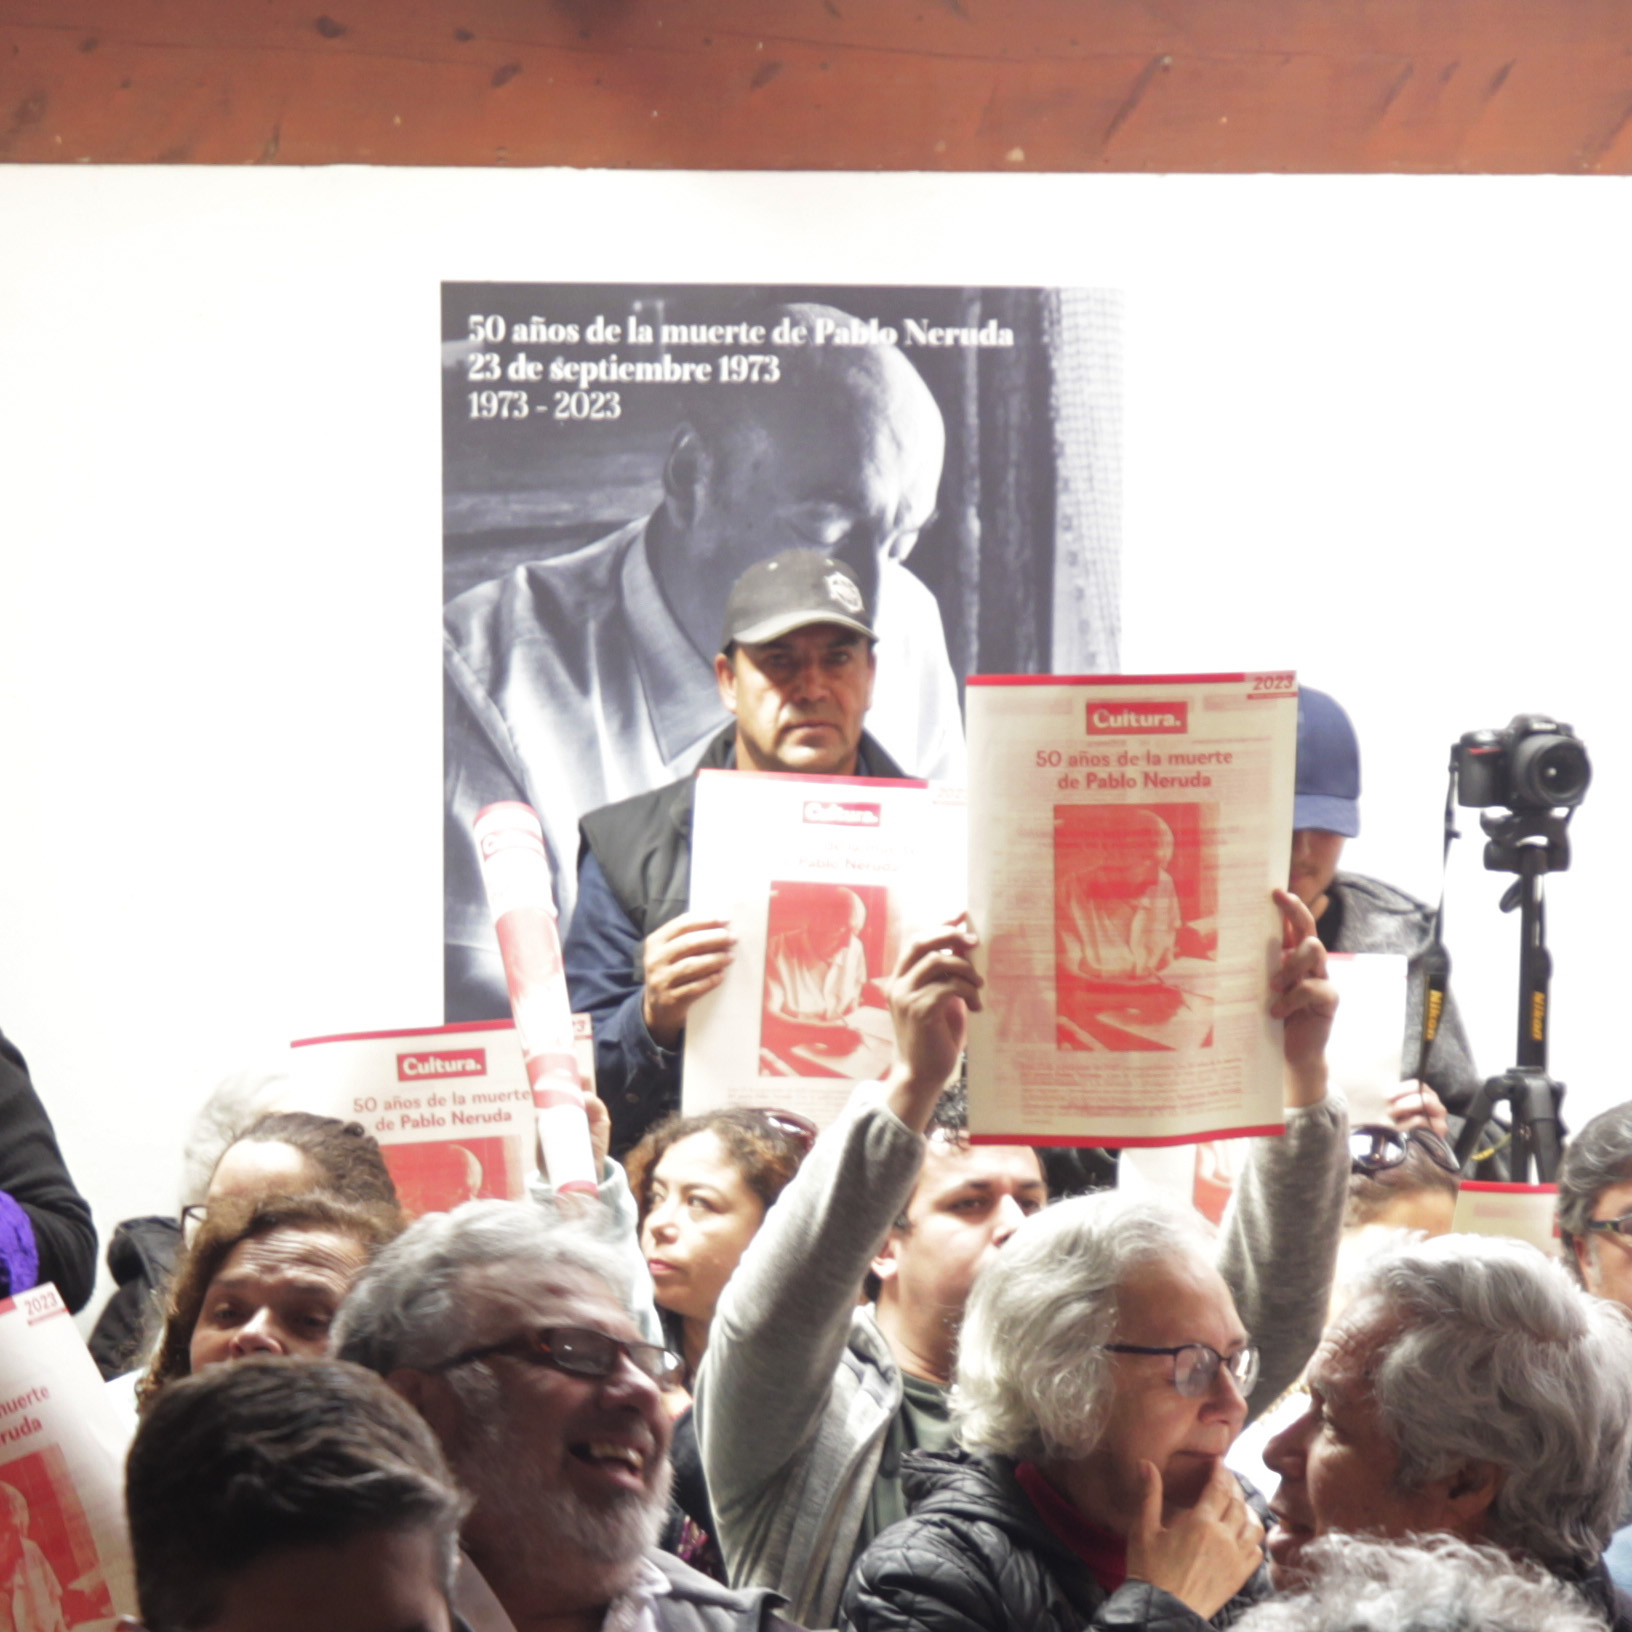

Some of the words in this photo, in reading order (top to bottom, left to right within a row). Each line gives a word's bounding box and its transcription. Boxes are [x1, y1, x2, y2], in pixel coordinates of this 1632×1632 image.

[468, 314, 507, 344] 50
[511, 315, 581, 345] años
[585, 315, 622, 345] de
[626, 315, 654, 345] la
[661, 322, 766, 345] muerte
[771, 316, 808, 346] de
[813, 317, 899, 346] Pablo
[902, 317, 1015, 347] Neruda
[467, 352, 502, 382] 23
[507, 352, 544, 382] de
[549, 353, 713, 389] septiembre
[718, 354, 781, 384] 1973
[467, 390, 529, 419] 1973
[553, 391, 622, 420] 2023
[1252, 676, 1295, 691] 2023
[1093, 709, 1181, 729] Cultura.
[1035, 750, 1062, 768] 50
[1068, 749, 1111, 768] años
[1117, 750, 1140, 767] de
[1146, 749, 1162, 767] la
[1167, 750, 1234, 766] muerte
[1057, 773, 1080, 790] de
[1085, 772, 1137, 790] Pablo
[1143, 771, 1212, 789] Neruda
[402, 1056, 482, 1076] Cultura.
[353, 1096, 378, 1113] 50
[383, 1095, 422, 1111] años
[427, 1092, 447, 1107] de
[452, 1091, 467, 1106] la
[471, 1088, 531, 1104] muerte
[375, 1116, 395, 1132] de
[400, 1113, 446, 1129] Pablo
[451, 1108, 513, 1126] Neruda
[24, 1291, 59, 1316] 2023
